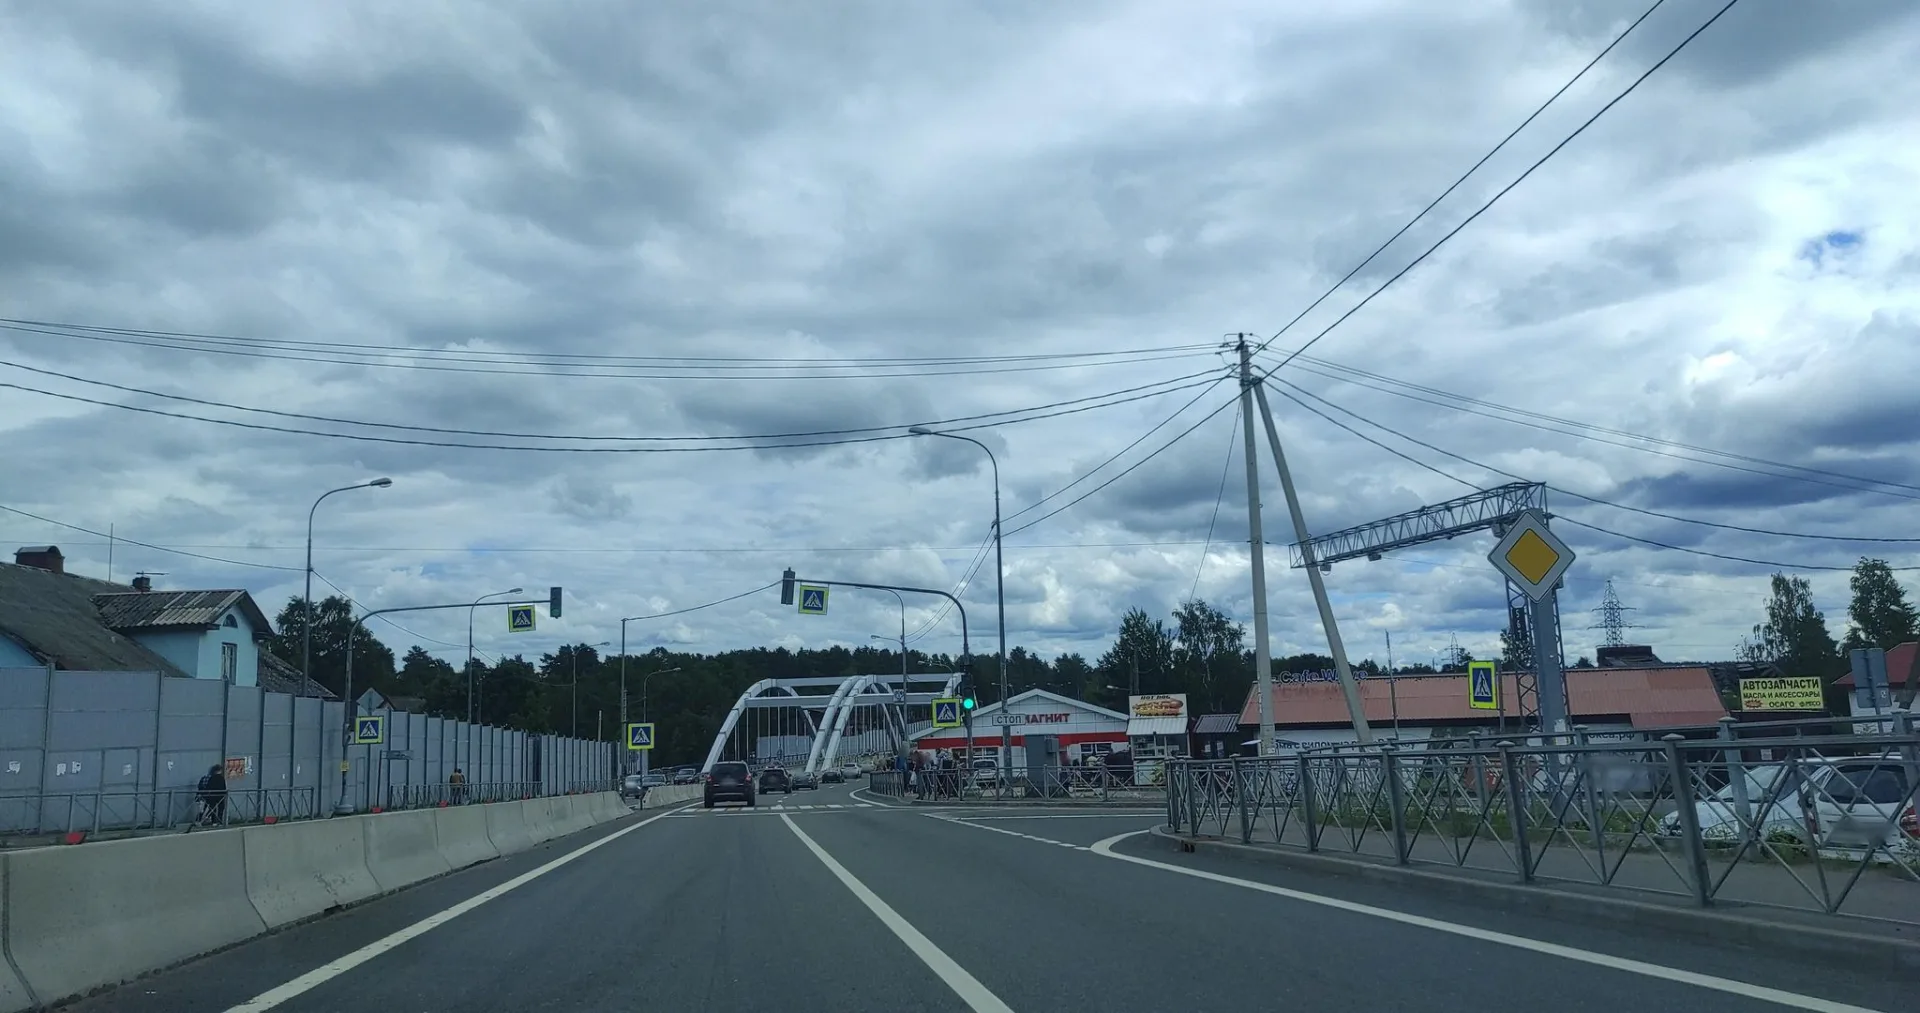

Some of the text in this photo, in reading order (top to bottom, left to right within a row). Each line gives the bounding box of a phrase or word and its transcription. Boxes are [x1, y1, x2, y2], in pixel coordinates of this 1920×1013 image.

[1280, 669, 1368, 683] Cafe Wve
[1743, 679, 1819, 690] АВТОЗАПЧАСТИ
[996, 715, 1022, 724] СТОП
